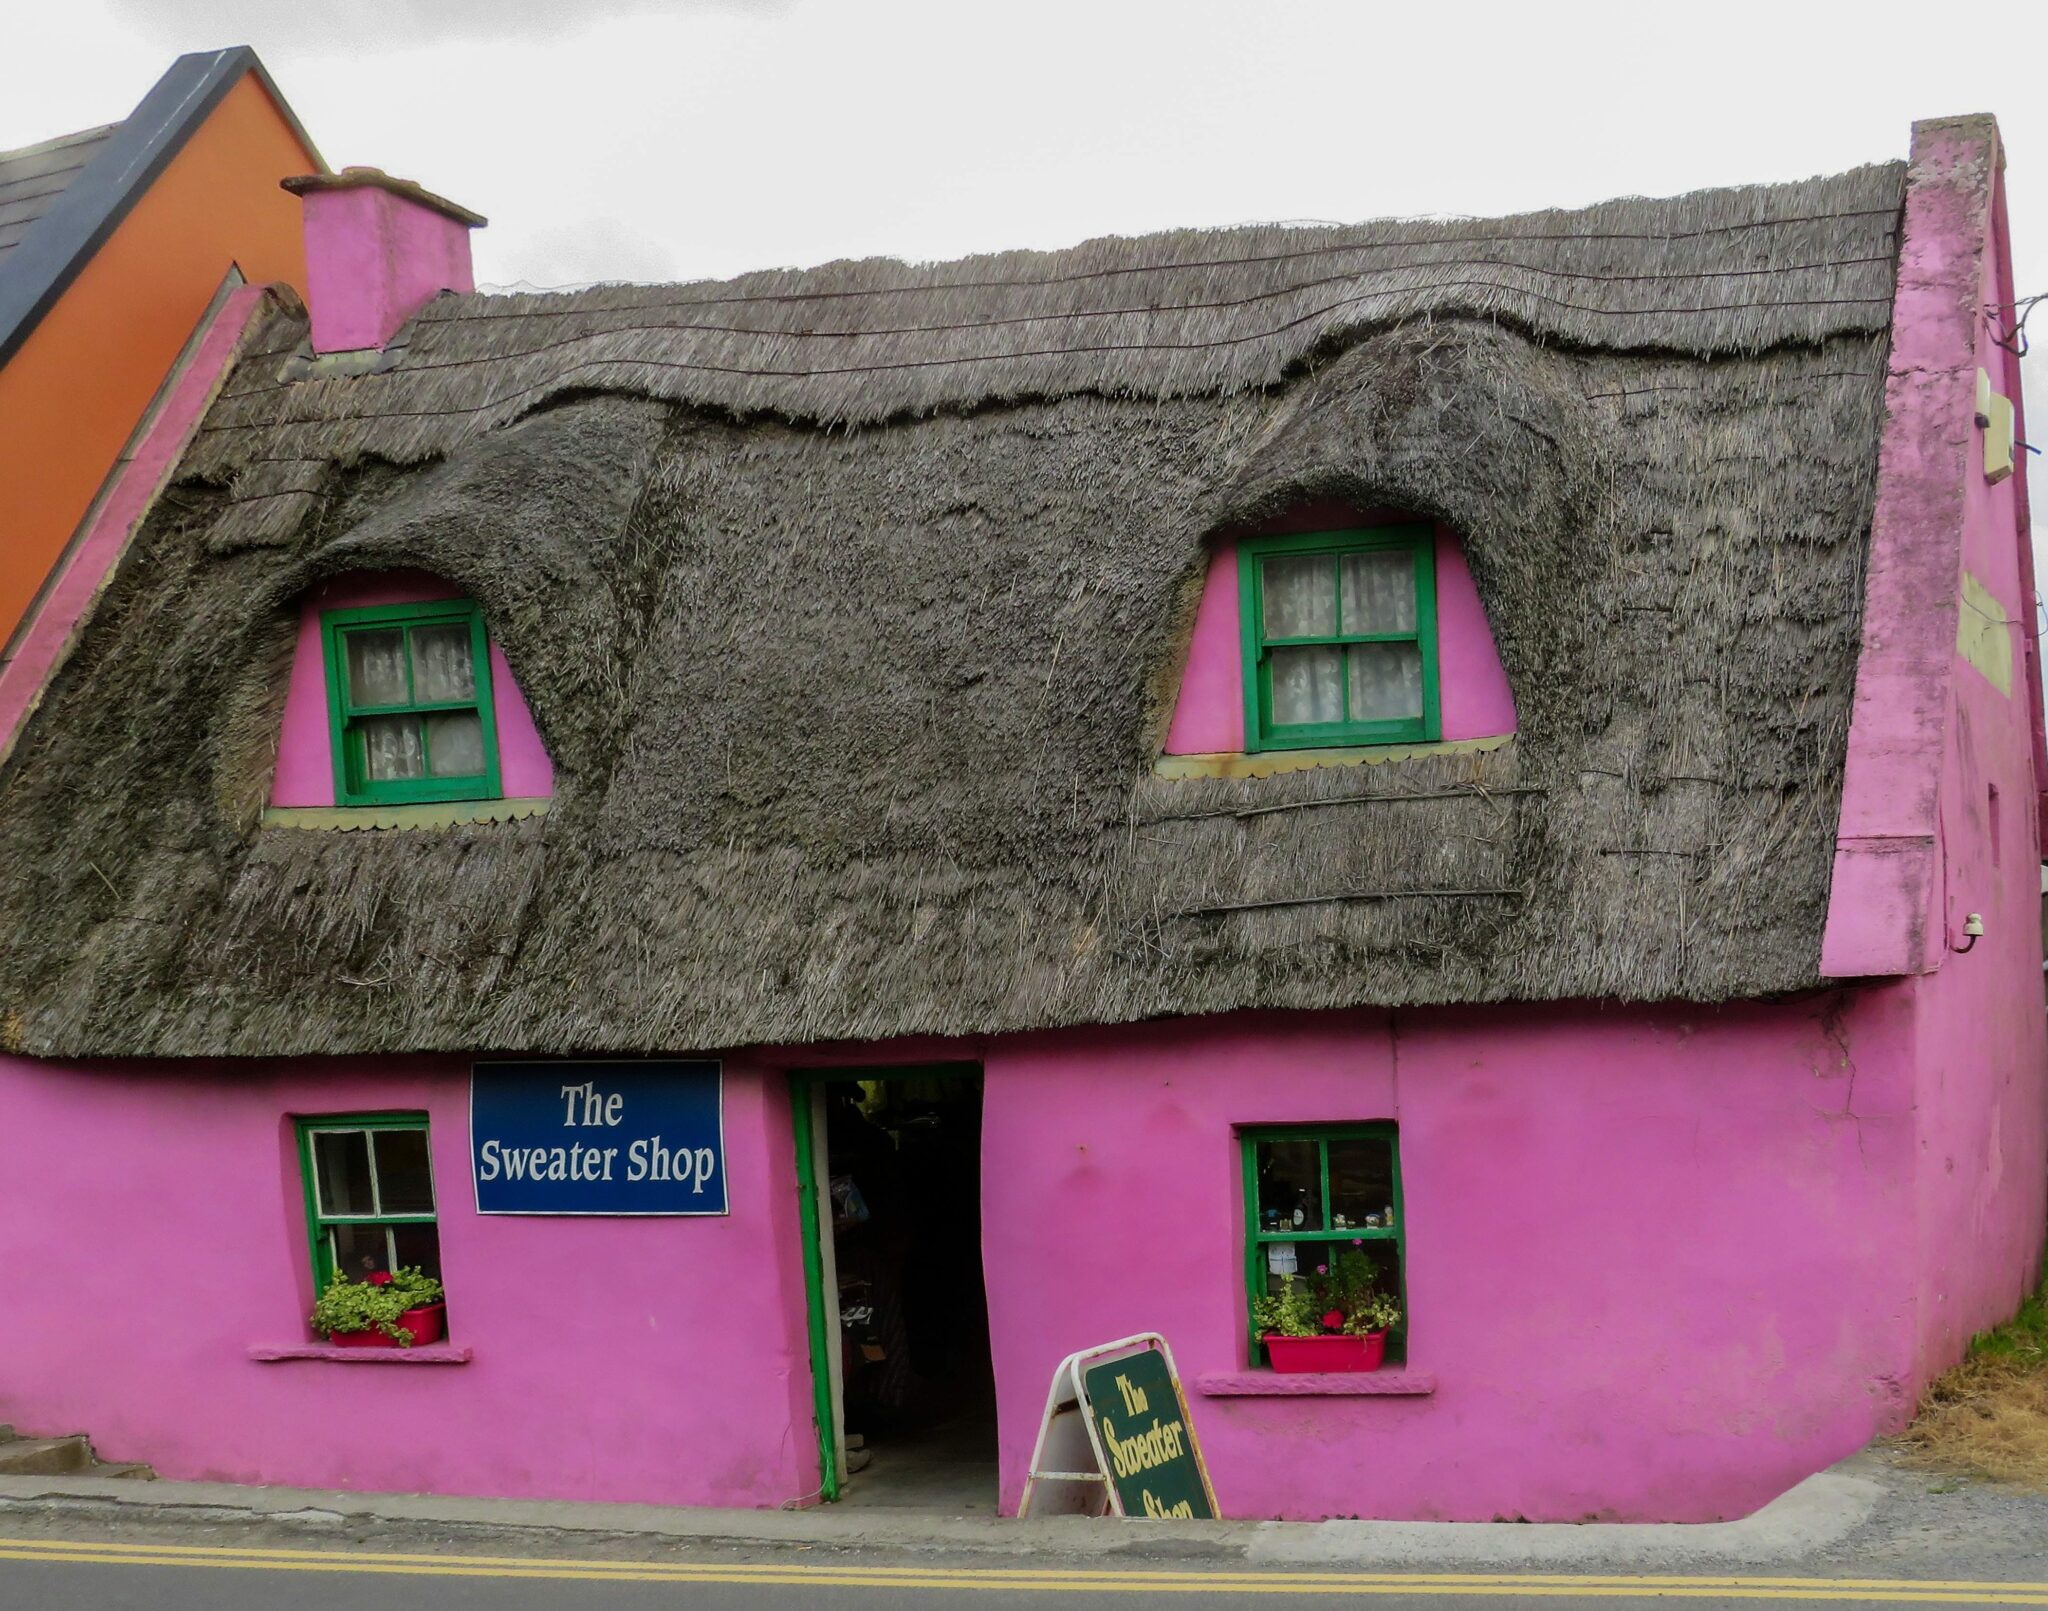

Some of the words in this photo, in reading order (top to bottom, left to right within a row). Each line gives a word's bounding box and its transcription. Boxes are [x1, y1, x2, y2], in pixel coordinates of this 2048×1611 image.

[561, 1081, 623, 1127] The
[480, 1140, 618, 1181] Sweater
[627, 1135, 714, 1194] Shop
[1103, 1417, 1184, 1478] Sweater
